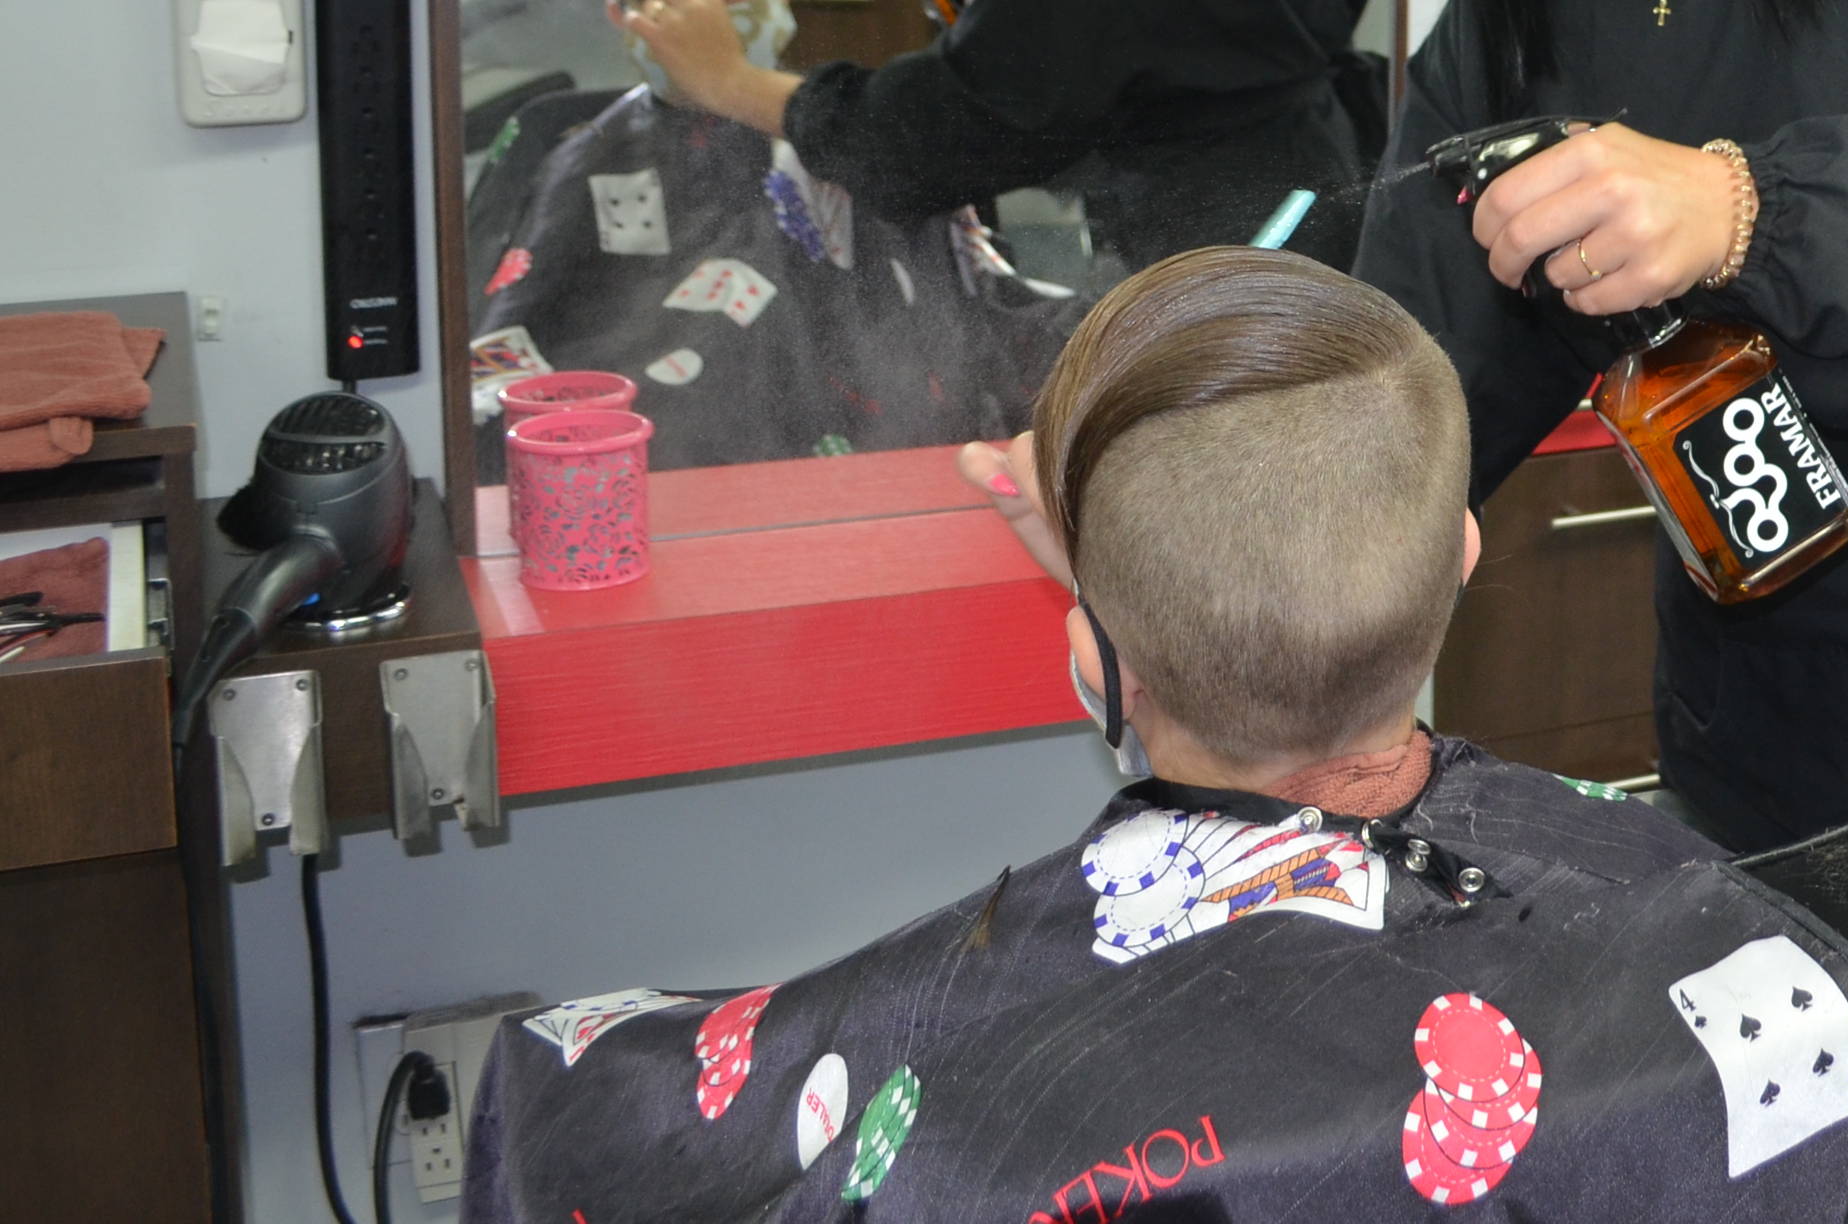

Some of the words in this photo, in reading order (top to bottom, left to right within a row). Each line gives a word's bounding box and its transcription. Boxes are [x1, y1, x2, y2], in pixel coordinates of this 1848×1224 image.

[1761, 382, 1841, 510] FRAMAR
[1680, 989, 1696, 1011] 4
[805, 1087, 835, 1143] DEALER
